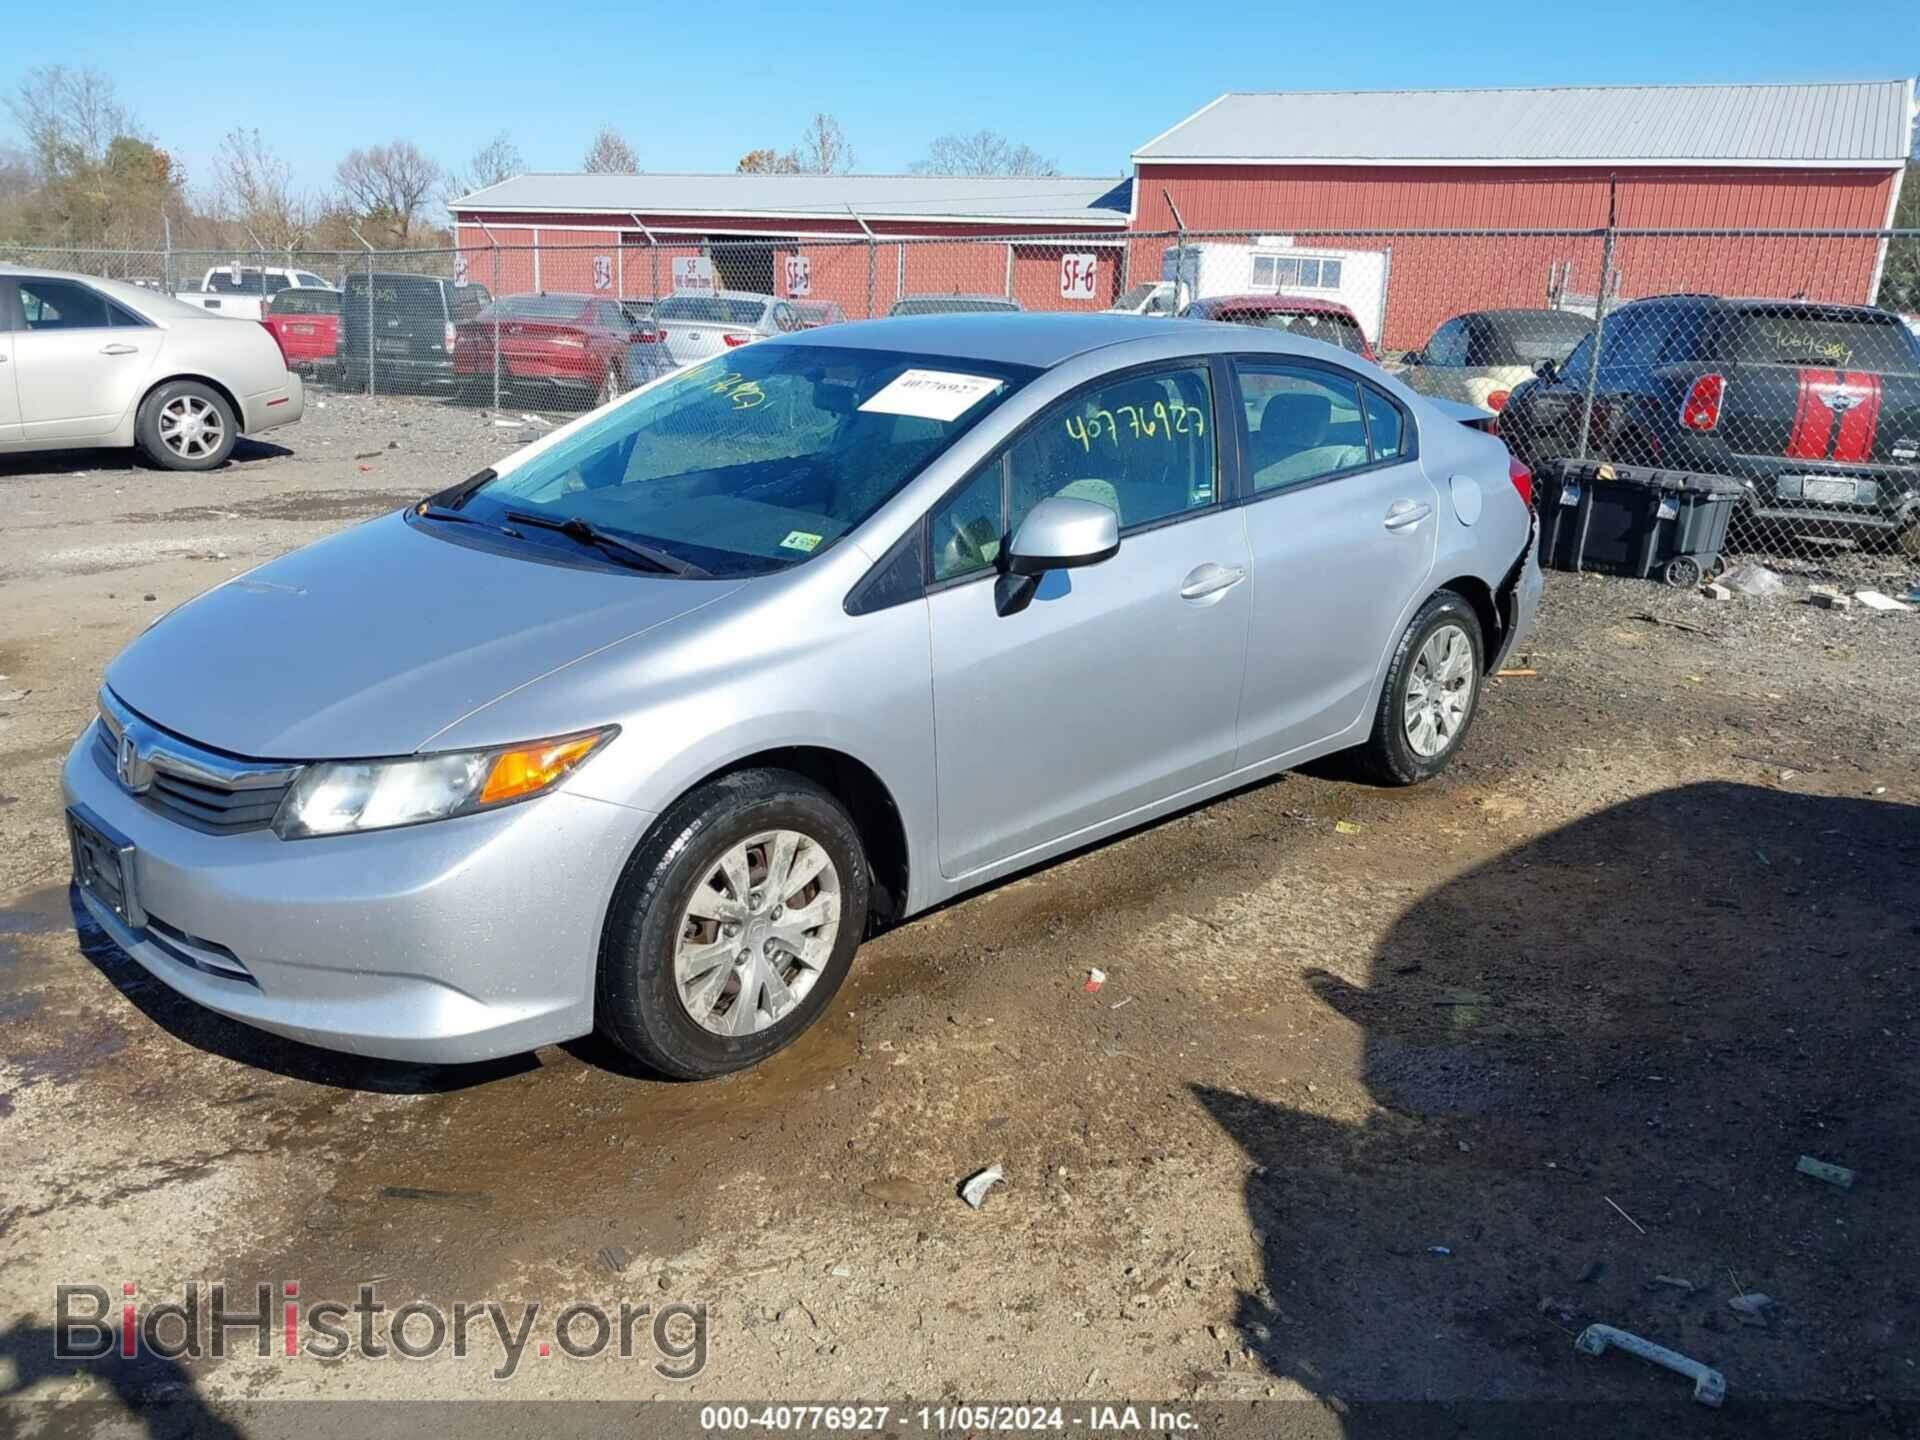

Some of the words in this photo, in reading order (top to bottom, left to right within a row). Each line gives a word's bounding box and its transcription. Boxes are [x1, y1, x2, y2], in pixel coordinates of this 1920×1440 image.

[787, 261, 809, 289] SF-5
[1063, 259, 1094, 292] SF-6
[1065, 401, 1204, 452] 40776927
